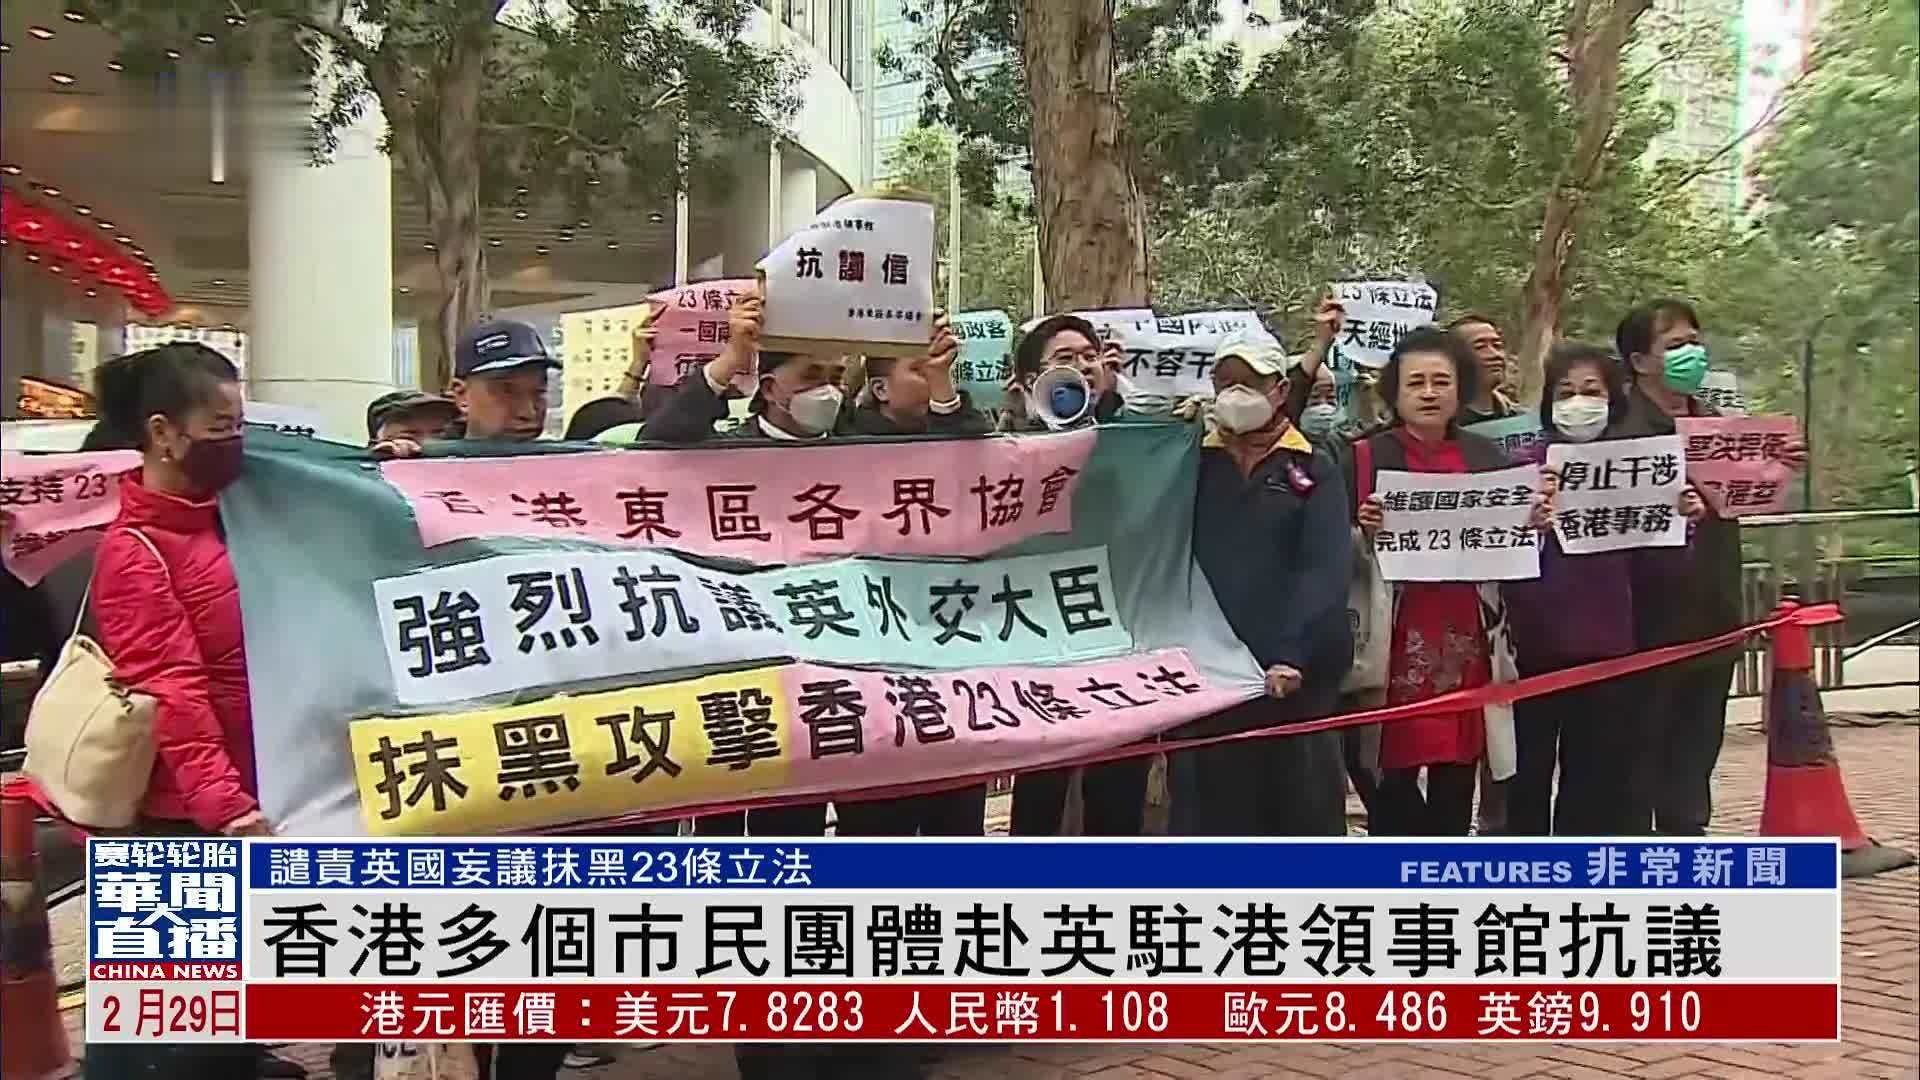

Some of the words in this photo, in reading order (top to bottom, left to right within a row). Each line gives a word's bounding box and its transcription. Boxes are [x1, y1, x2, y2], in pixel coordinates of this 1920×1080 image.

[796, 247, 909, 285] 抗議信
[677, 289, 697, 308] 23
[0, 476, 64, 505] 支持
[74, 472, 107, 499] 23
[1558, 453, 1679, 491] 停止干涉
[1383, 484, 1534, 512] 維護國家安全
[1556, 503, 1674, 540] 香港事務
[1376, 530, 1421, 552] 完成
[1428, 529, 1450, 550] 23
[1460, 525, 1536, 549] 條立法
